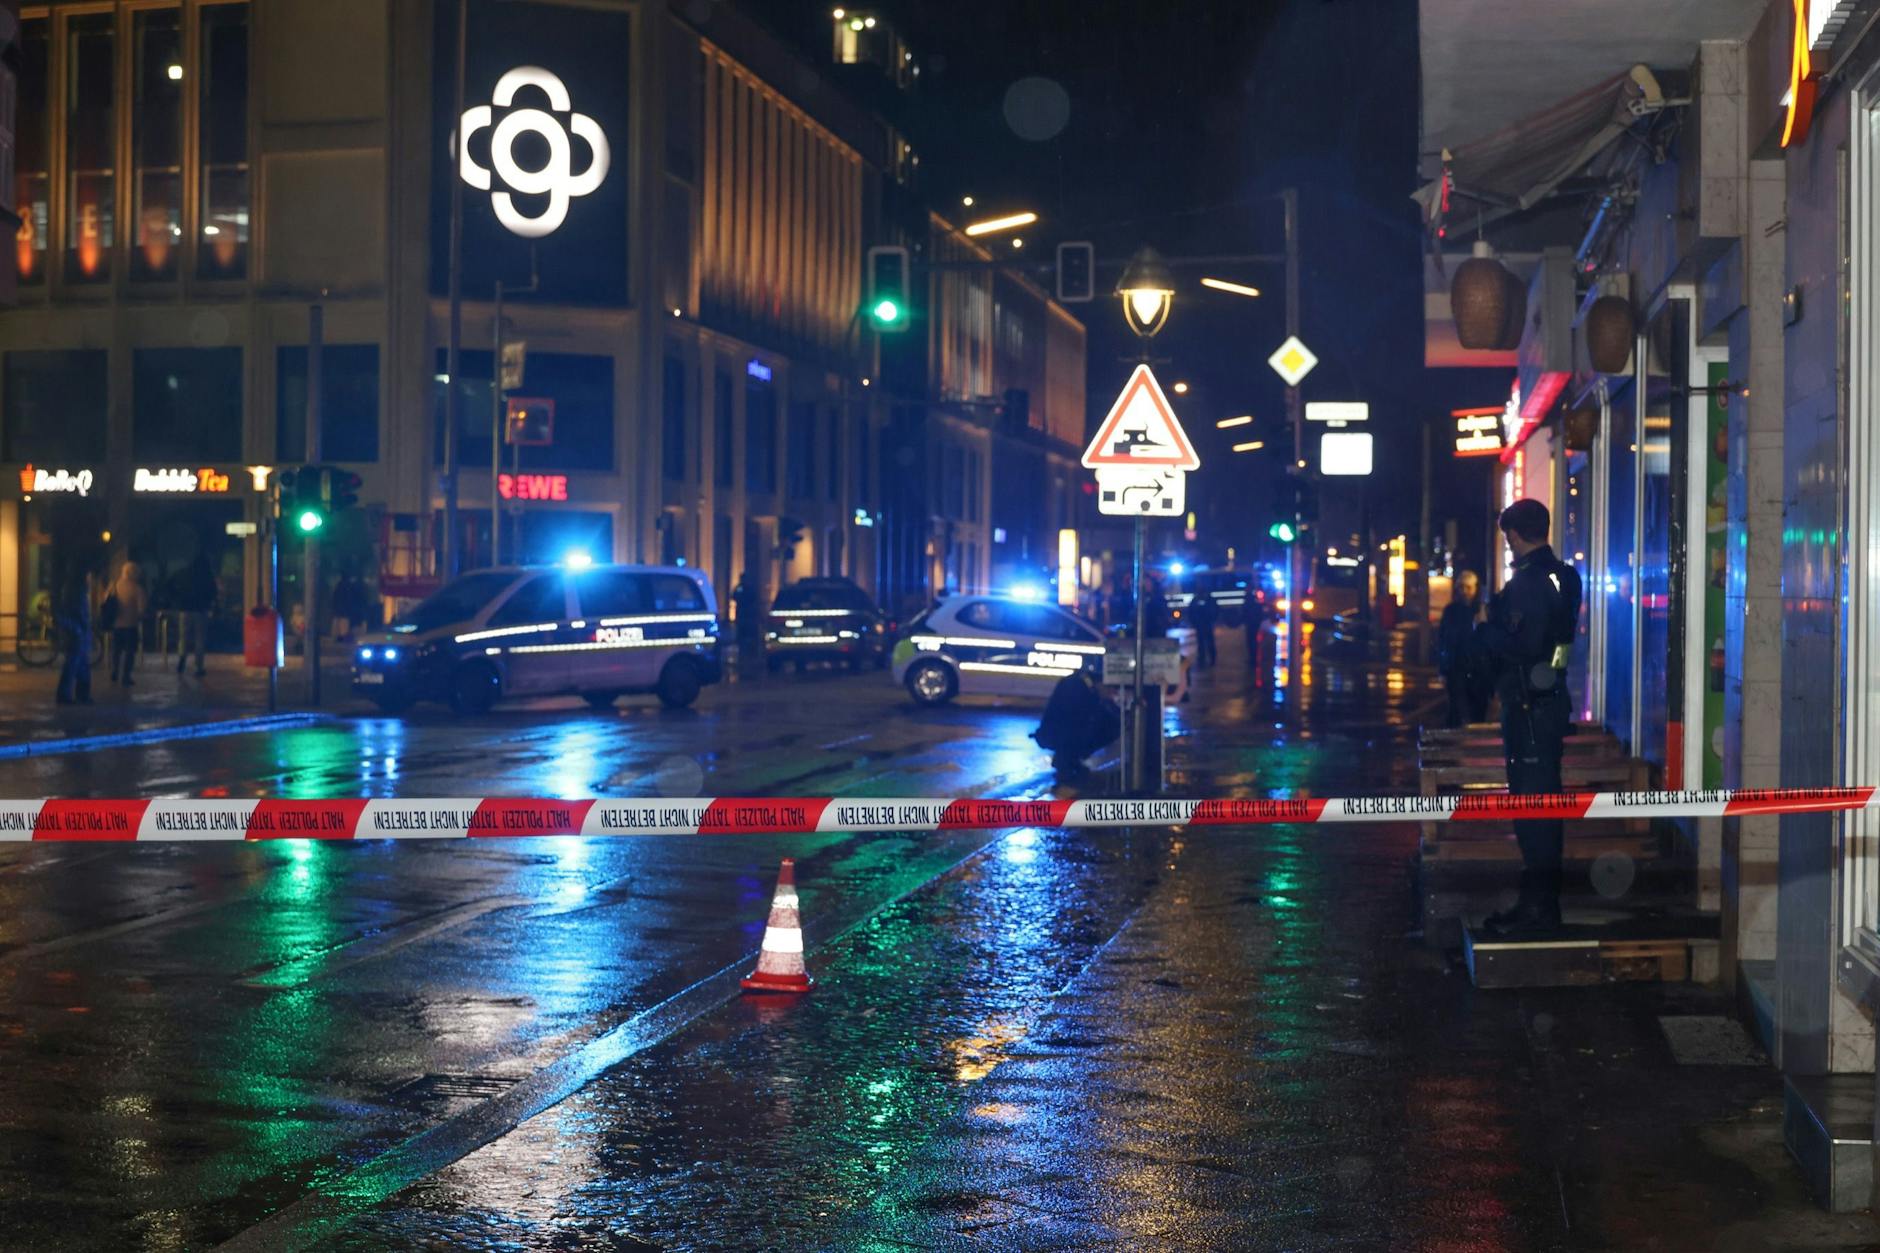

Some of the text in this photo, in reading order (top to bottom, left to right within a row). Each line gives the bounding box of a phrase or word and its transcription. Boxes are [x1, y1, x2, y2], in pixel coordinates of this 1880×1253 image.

[134, 469, 228, 491] Bubble Tea
[498, 474, 567, 500] REWE
[596, 627, 643, 642] POLIZEI
[1184, 800, 1226, 819] TATORT
[1231, 799, 1277, 818] POLIZEI!
[1280, 799, 1308, 817] HALT
[1343, 797, 1405, 815] BETRETEN!
[1409, 796, 1444, 814] NICHT
[1448, 793, 1489, 812] TATORT
[1547, 792, 1577, 809] HALT
[279, 811, 318, 830] POLIZEI!
[320, 811, 345, 830] HALT
[373, 811, 427, 830] BETRETEN!
[428, 811, 459, 830] NICHT
[461, 811, 498, 829] TATORT
[502, 810, 544, 829] POLIZEI!
[546, 810, 571, 829] HALT
[601, 809, 656, 828] BETRETEN!
[658, 809, 690, 828] NICHT
[692, 808, 730, 827] TATORT
[734, 807, 777, 826] POLIZEI!
[780, 807, 806, 826] HALT
[837, 807, 894, 826] BETRETEN!
[898, 806, 930, 825] NICHT
[932, 805, 972, 824] TATORT
[977, 804, 1021, 823] POLIZEI!
[1025, 804, 1052, 823] HALT
[1085, 802, 1144, 821] BETRETEN!
[1148, 802, 1181, 820] NICHT
[28, 812, 61, 831] TATORT
[65, 812, 102, 831] POLIZEI!
[105, 812, 128, 830] HALT
[156, 812, 207, 831] BETRETEN!
[208, 812, 238, 831] NICHT
[241, 812, 275, 830] TATORT
